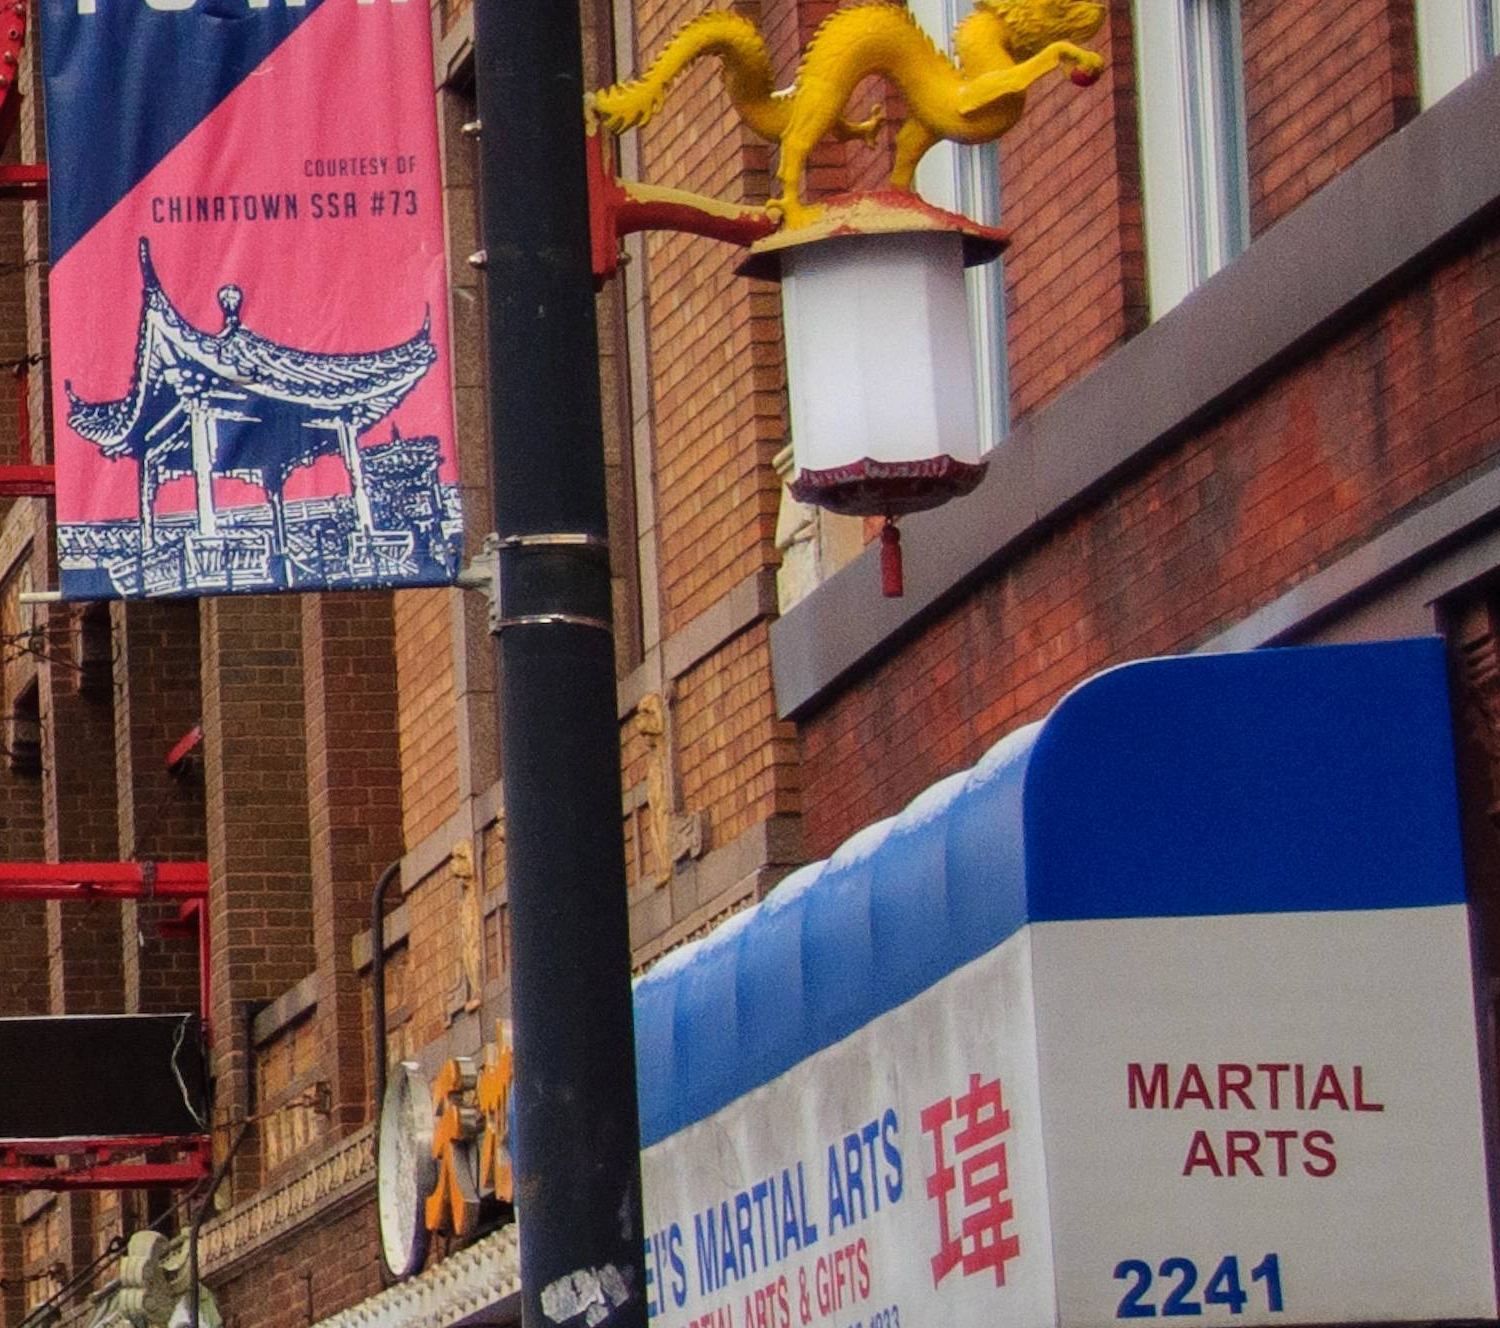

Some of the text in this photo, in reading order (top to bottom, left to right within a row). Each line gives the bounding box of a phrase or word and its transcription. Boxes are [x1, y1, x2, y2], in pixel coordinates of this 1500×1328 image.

[302, 156, 417, 179] COURTESY OF
[151, 192, 418, 226] CHINATOWN SSA #73
[1126, 1062, 1385, 1113] MARTIAL
[1181, 1129, 1339, 1179] ARTS
[644, 1107, 905, 1320] EI'S MARTIAL ARTS
[799, 1265, 812, 1327] &
[815, 1236, 871, 1318] GIFTS
[1113, 1252, 1285, 1319] 2241
